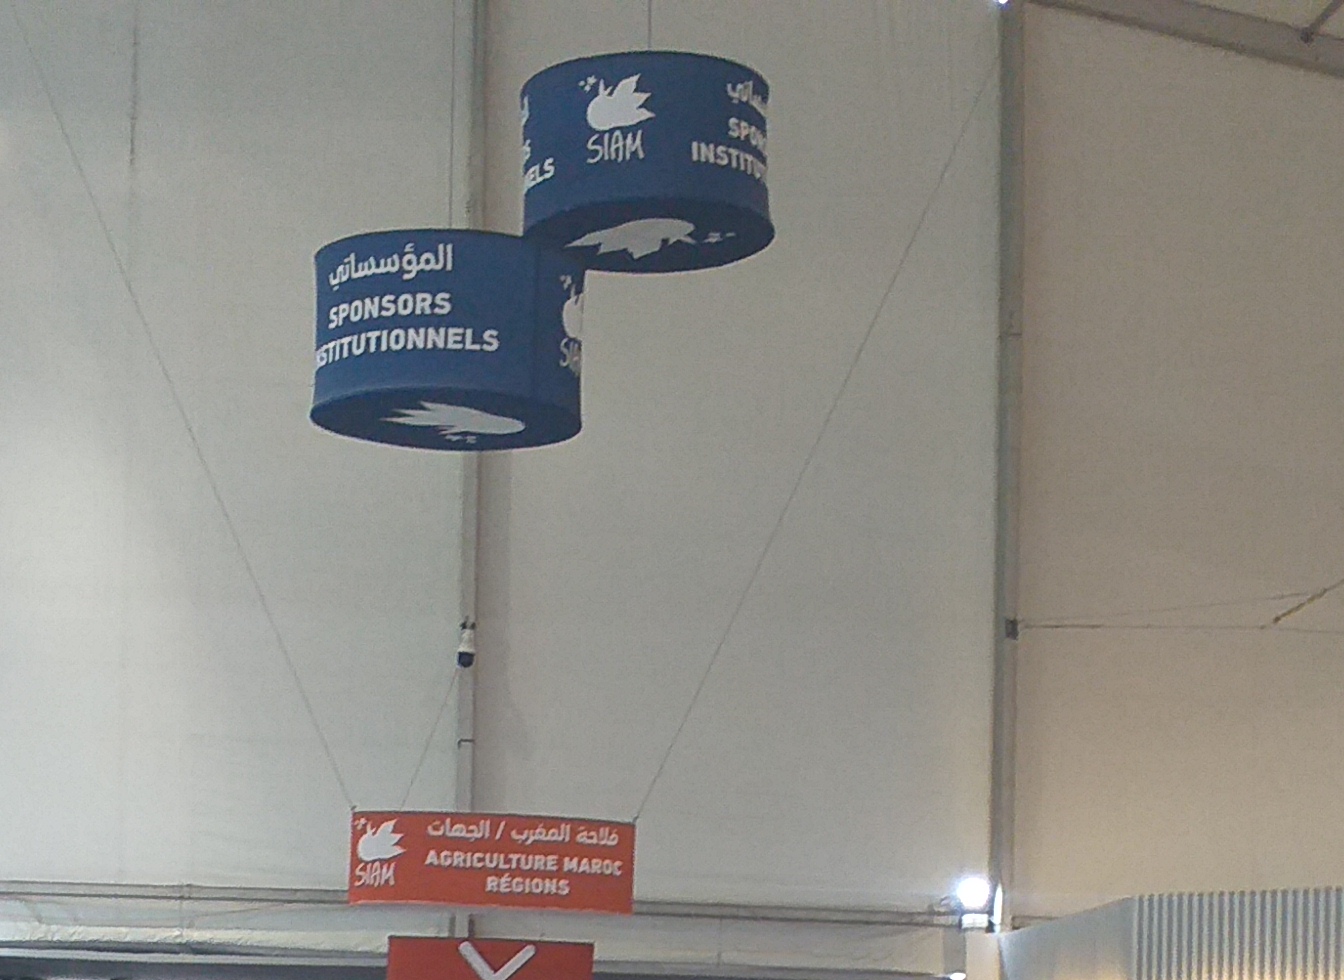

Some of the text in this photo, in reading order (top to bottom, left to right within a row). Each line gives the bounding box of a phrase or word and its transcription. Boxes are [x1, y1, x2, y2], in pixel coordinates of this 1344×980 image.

[586, 129, 646, 164] SIAM
[328, 241, 453, 290] المؤسساتي
[327, 291, 452, 330] SPONSORS
[425, 817, 491, 842] الجهات
[510, 822, 571, 846] المغرب
[574, 825, 620, 847] فلاحة
[353, 861, 397, 888] SIAM
[425, 849, 625, 877] AGRICULTURE MAROC
[484, 873, 571, 896] RÉGIONS
